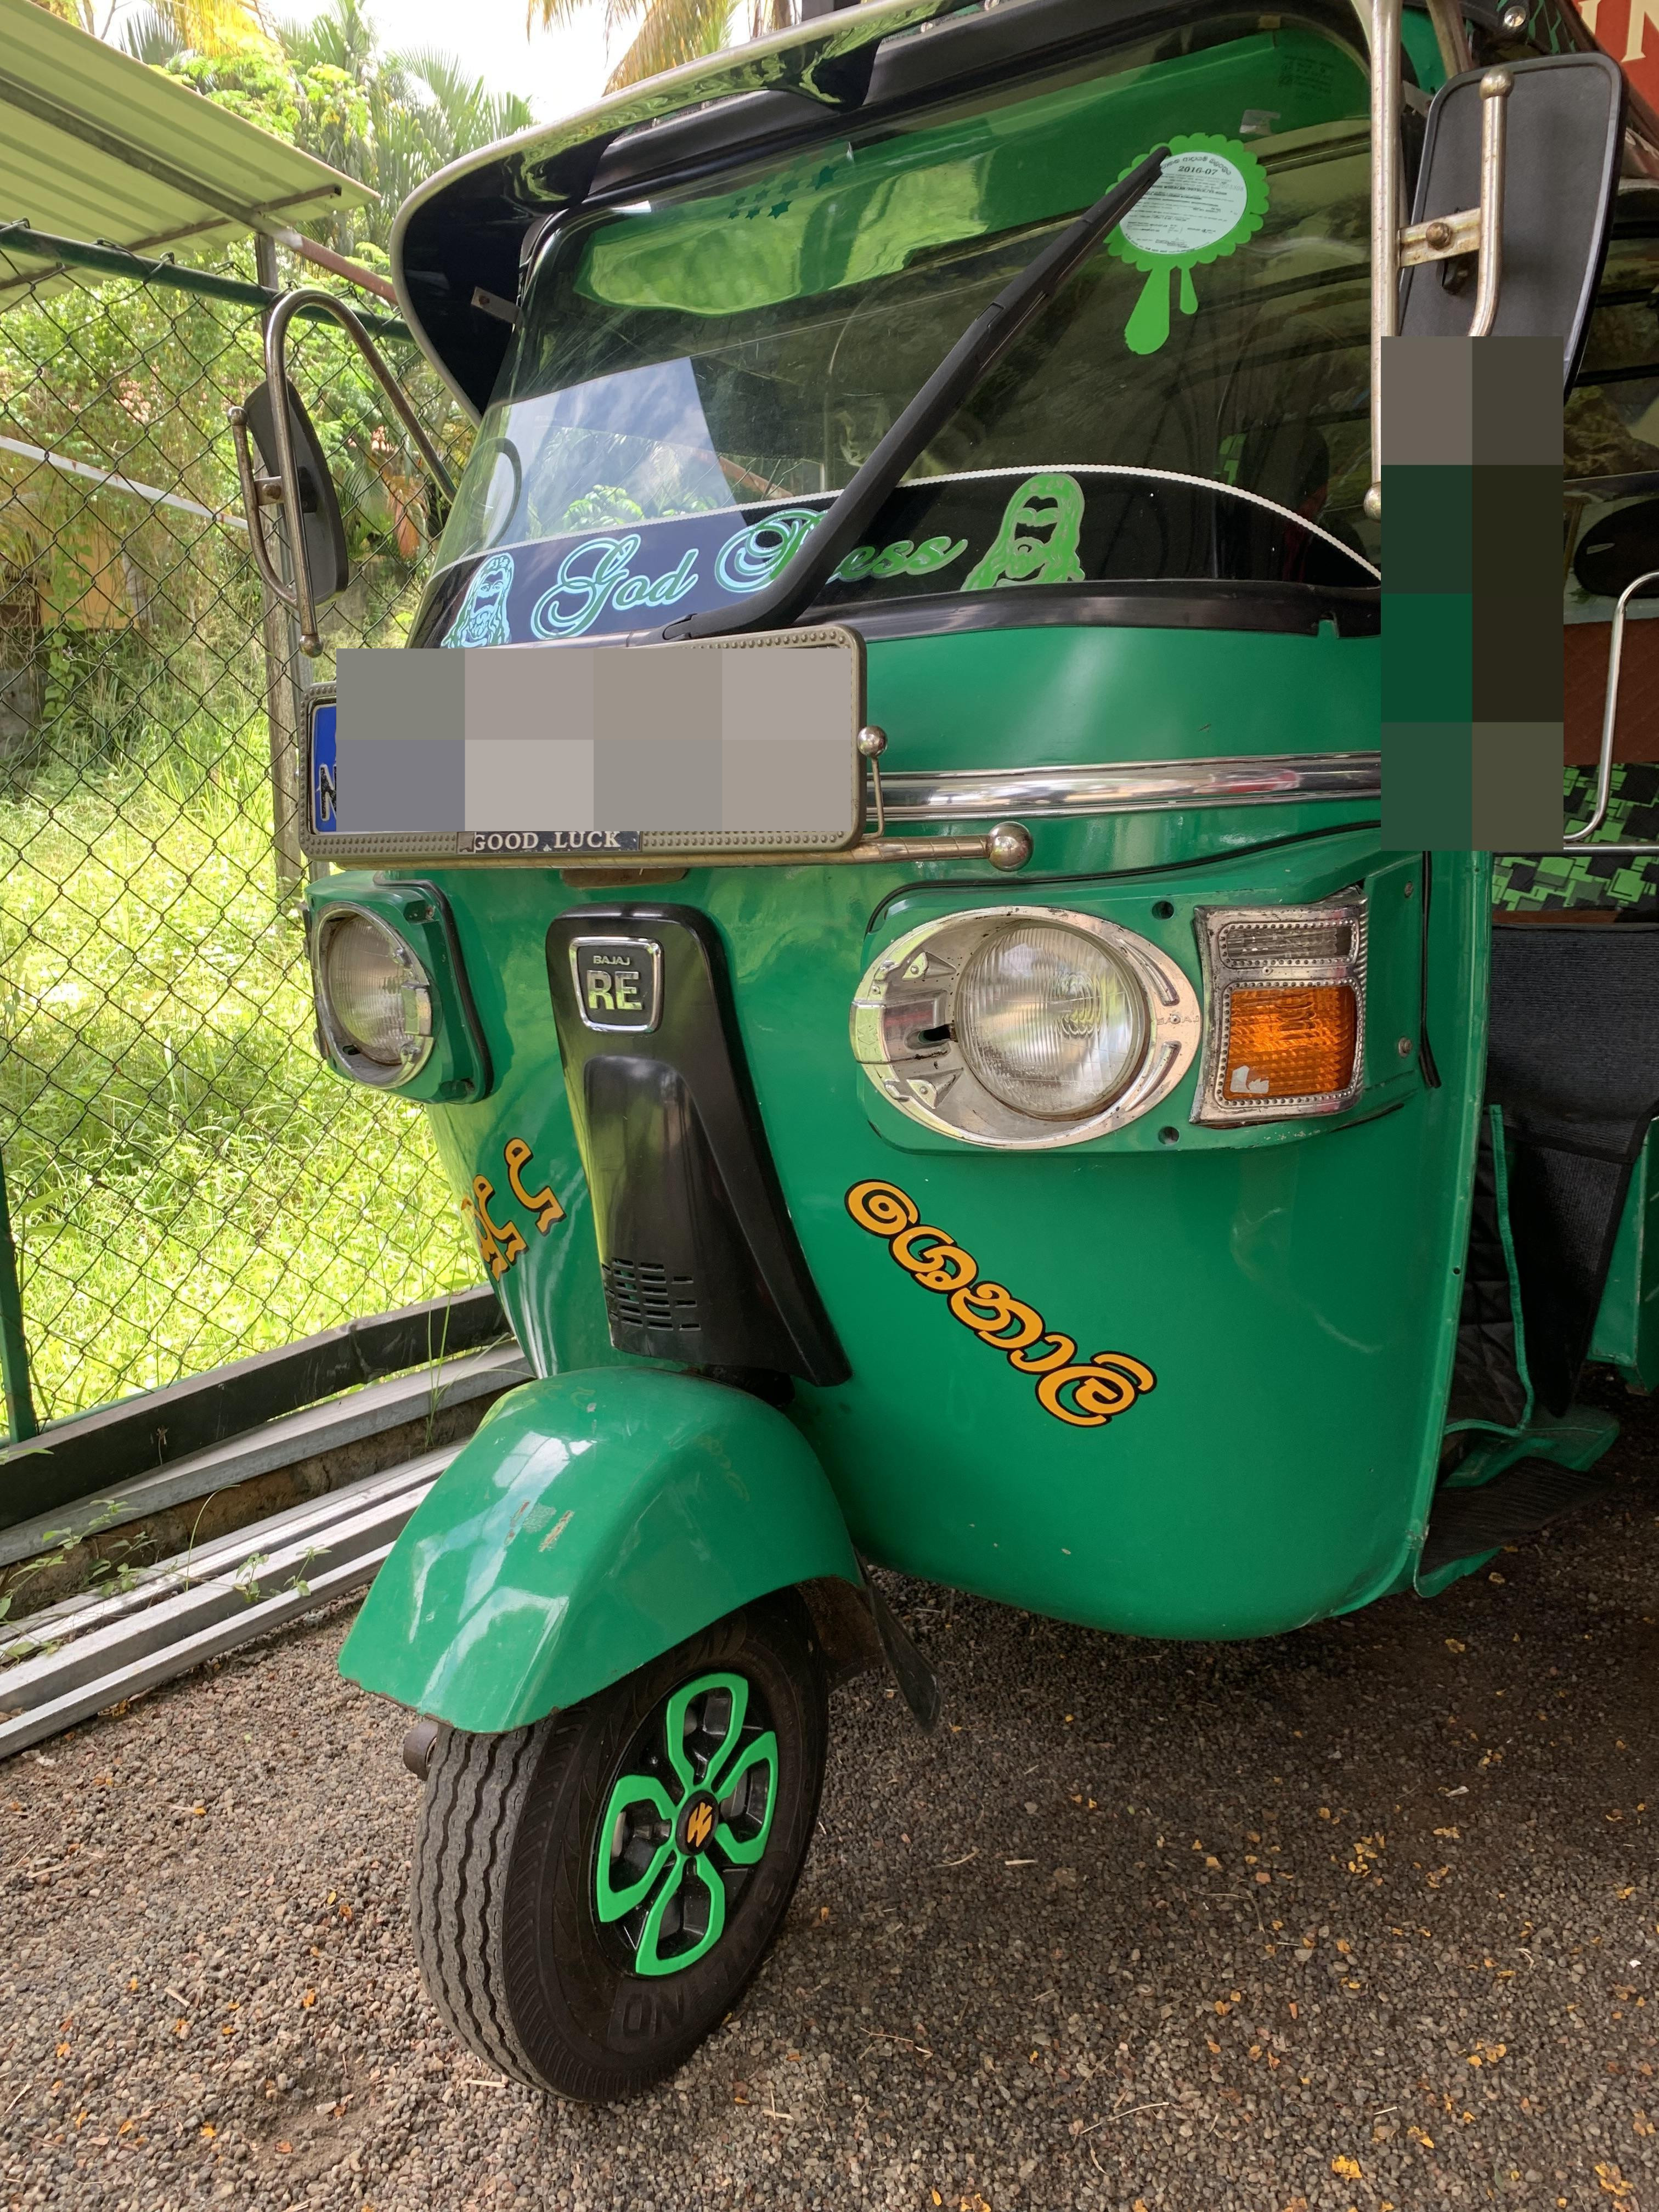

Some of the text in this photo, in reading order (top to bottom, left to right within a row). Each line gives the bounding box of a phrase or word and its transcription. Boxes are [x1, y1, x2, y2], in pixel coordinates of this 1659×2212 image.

[1178, 165, 1218, 176] 2016-07
[531, 508, 968, 641] God Bess
[473, 830, 621, 851] GOOD LUCK
[592, 955, 630, 966] BAJAJ
[586, 969, 643, 1011] RE
[1156, 1015, 1199, 1025] BAAJ
